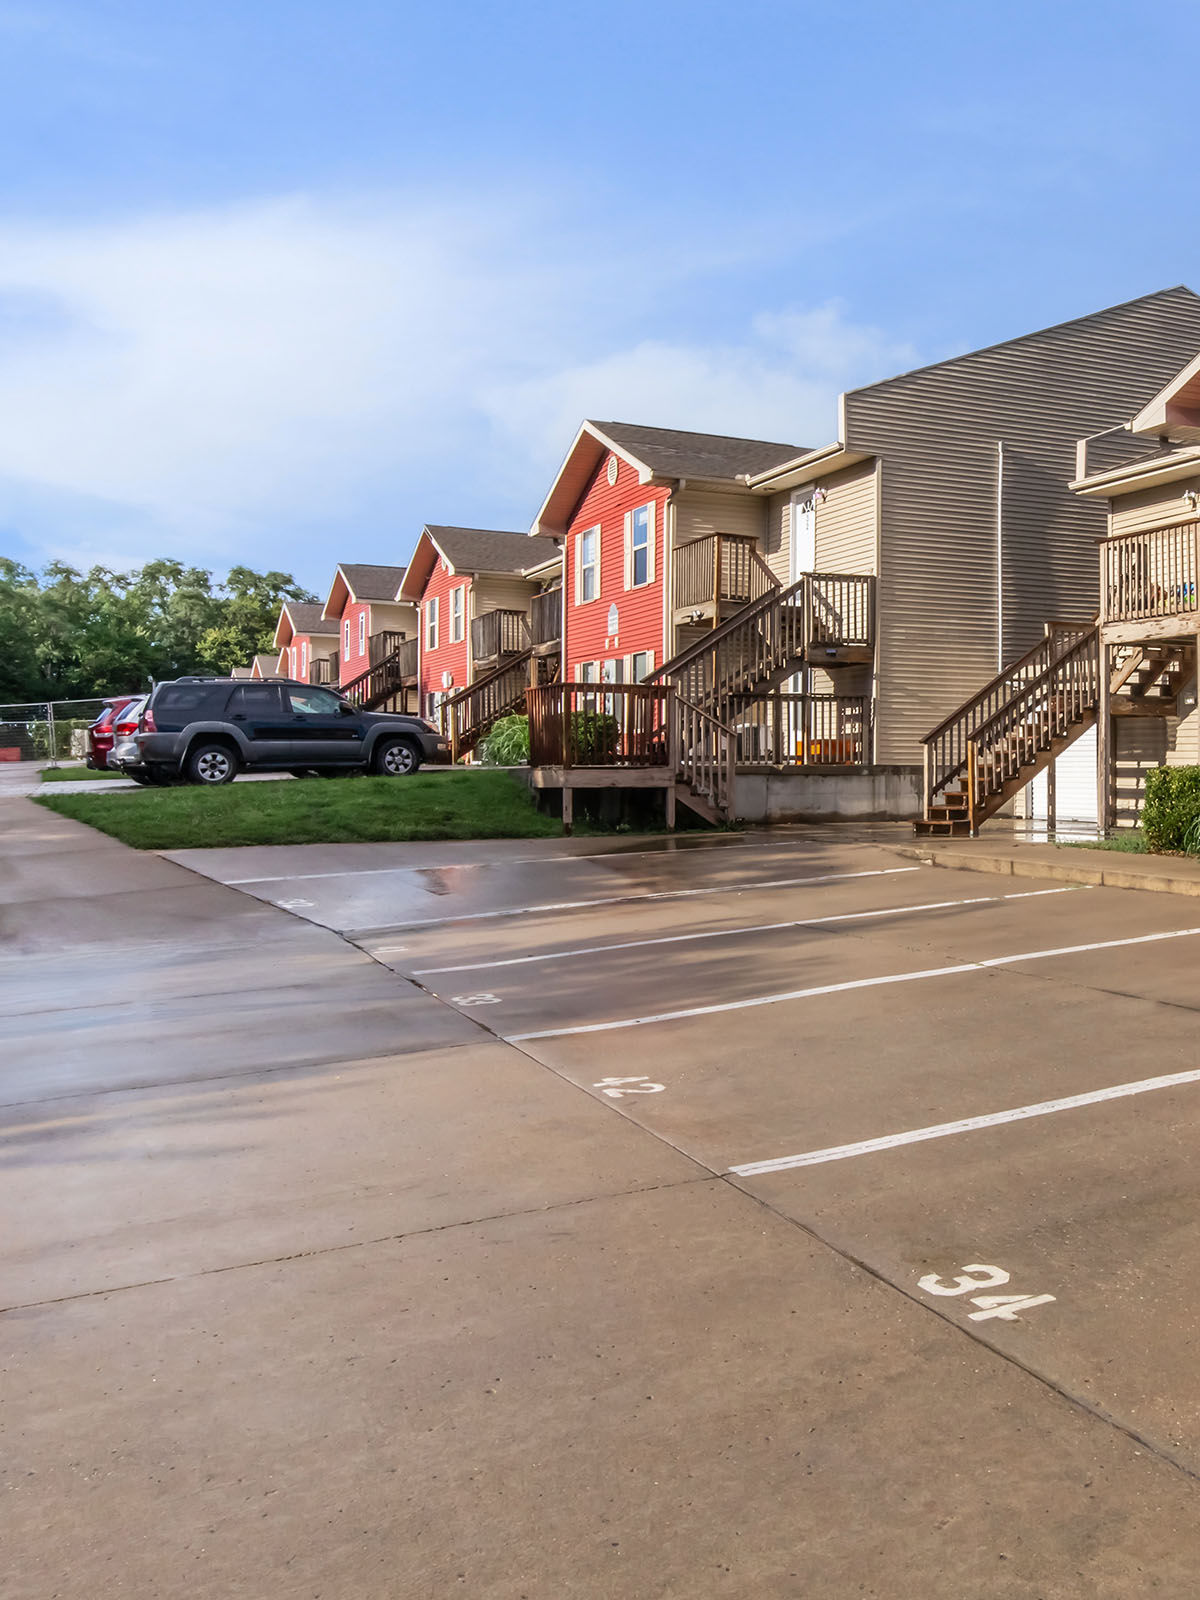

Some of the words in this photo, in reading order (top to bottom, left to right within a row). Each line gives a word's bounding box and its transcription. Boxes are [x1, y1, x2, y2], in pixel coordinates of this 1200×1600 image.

[450, 993, 503, 1007] 33
[592, 1075, 667, 1099] 42
[916, 1263, 1057, 1322] 34
